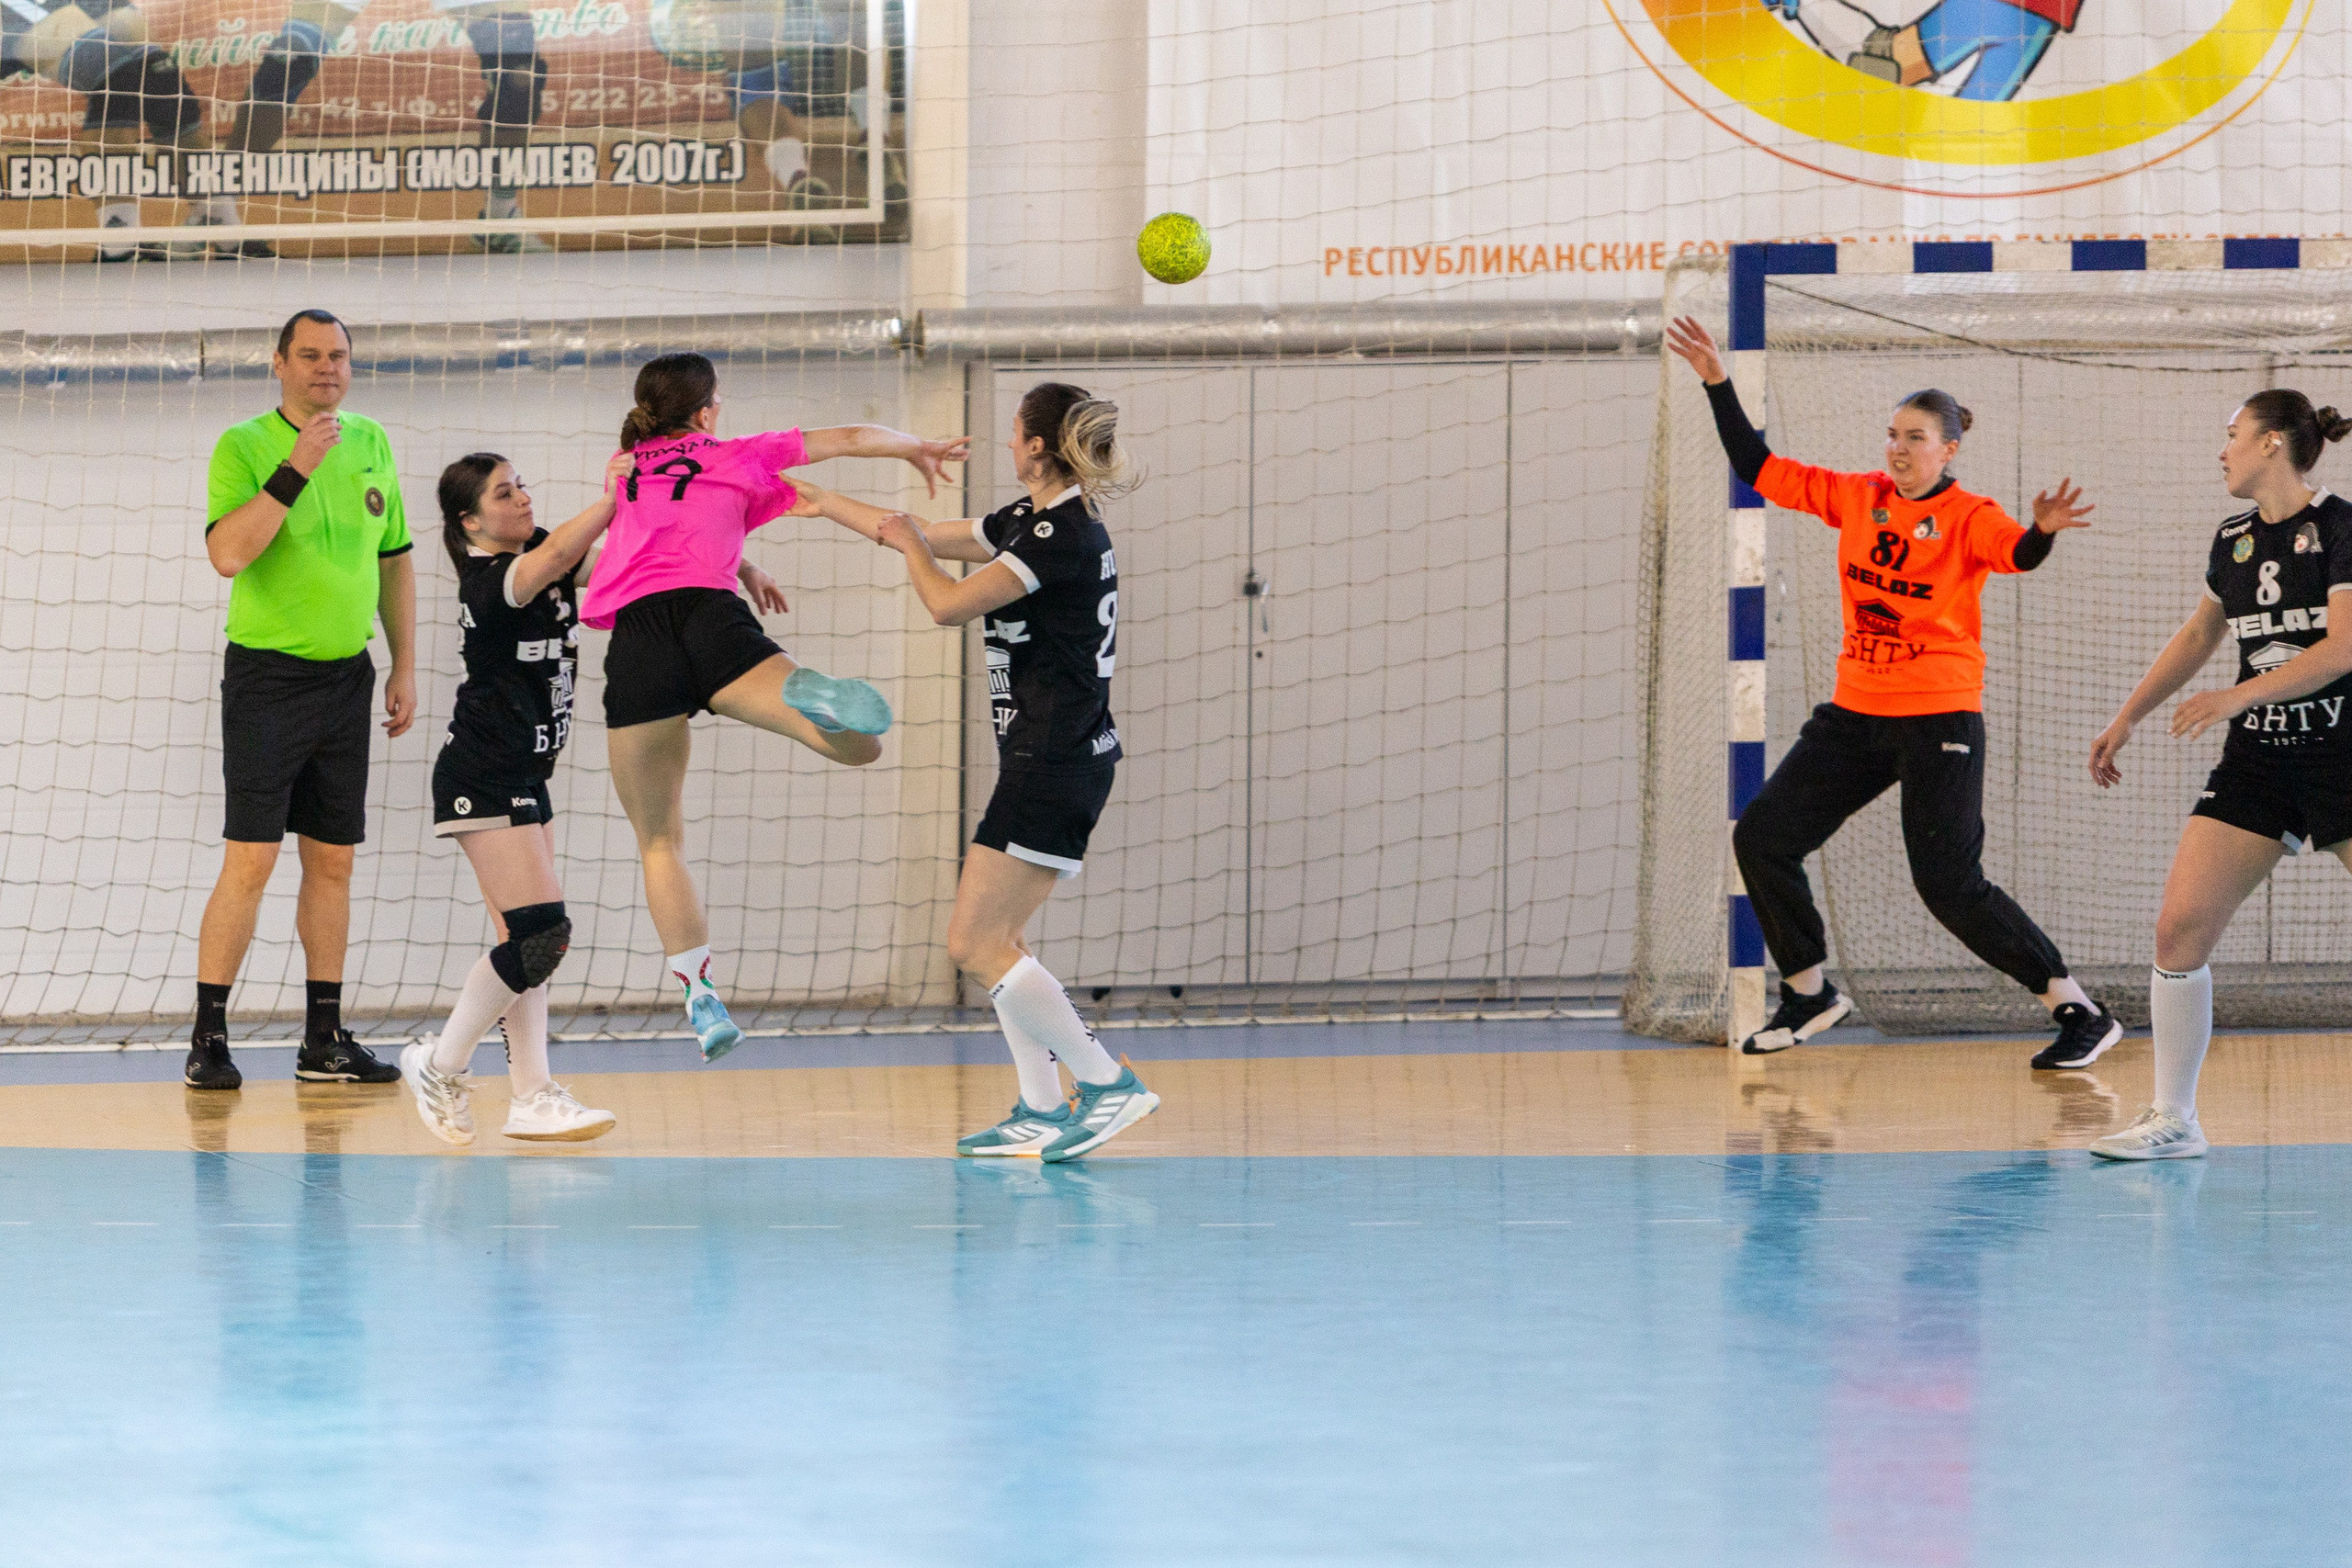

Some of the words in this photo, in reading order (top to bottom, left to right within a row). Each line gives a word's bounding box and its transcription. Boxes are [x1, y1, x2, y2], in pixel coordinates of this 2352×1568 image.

[569, 87, 628, 111] 222
[187, 150, 397, 198] ЖЕНЩИНЫ
[612, 141, 744, 184] 2007г.)
[1324, 241, 1666, 276] РЕСПУБЛИКАНСКИЕ
[1870, 530, 1910, 572] 81
[1846, 561, 1934, 600] BELAZ
[2256, 560, 2281, 605] 8
